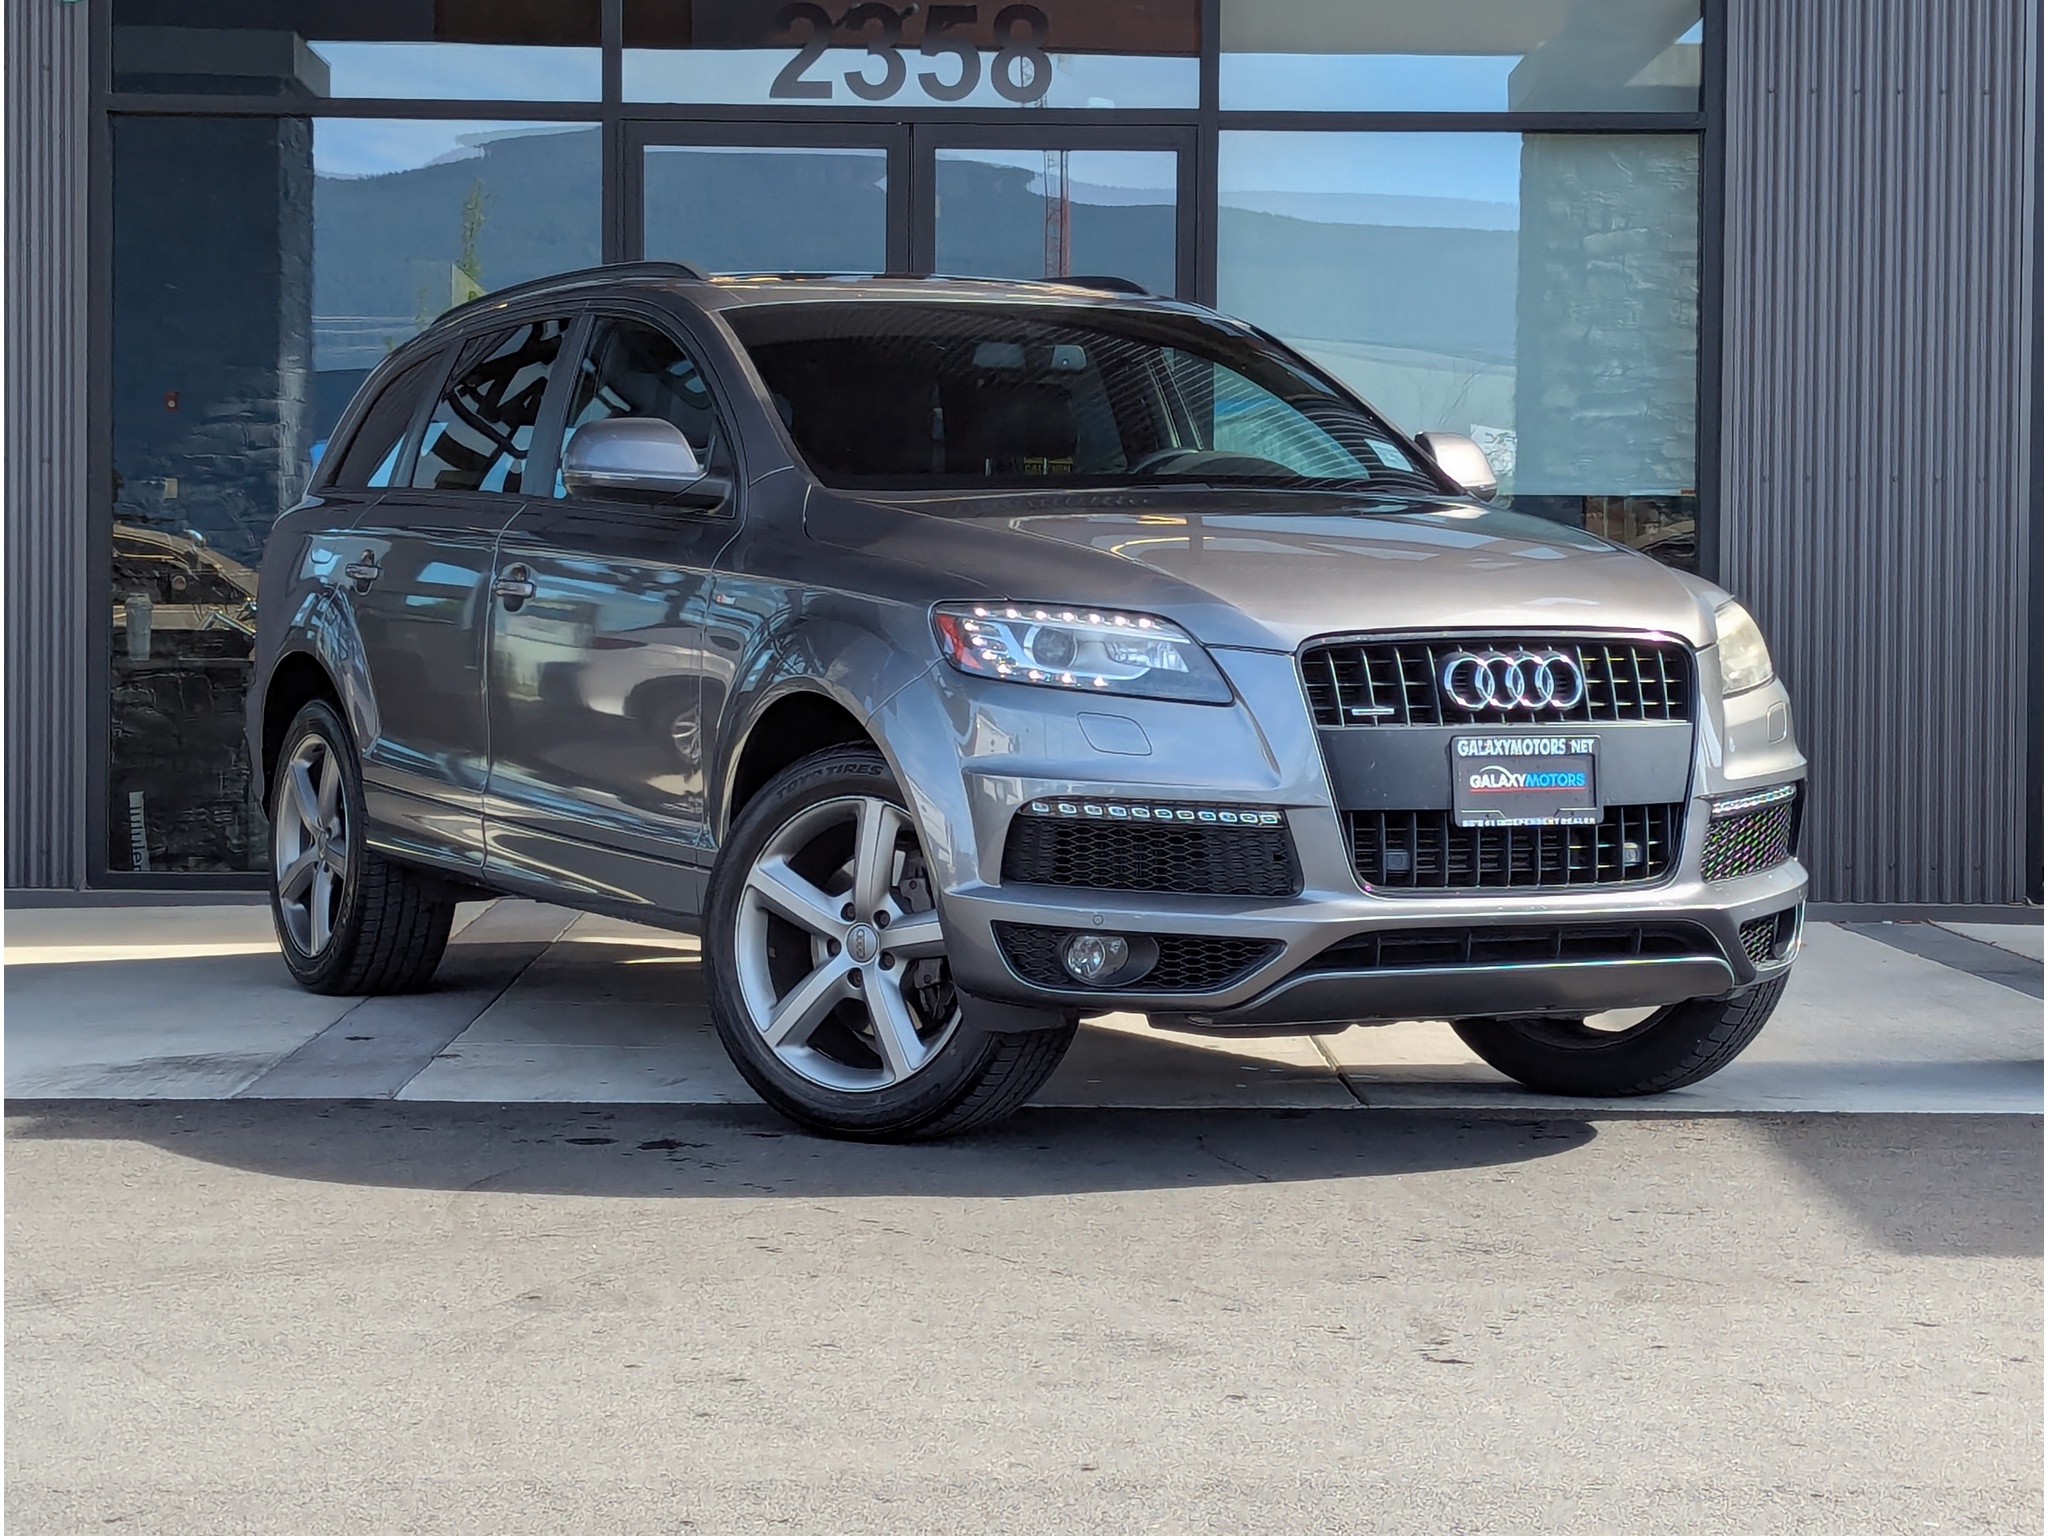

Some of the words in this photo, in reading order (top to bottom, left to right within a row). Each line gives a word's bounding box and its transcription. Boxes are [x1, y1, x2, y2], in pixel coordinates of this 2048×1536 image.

[769, 3, 1053, 102] 2358
[1457, 738, 1566, 756] GALAXYMOTORS
[825, 763, 884, 776] TIRES
